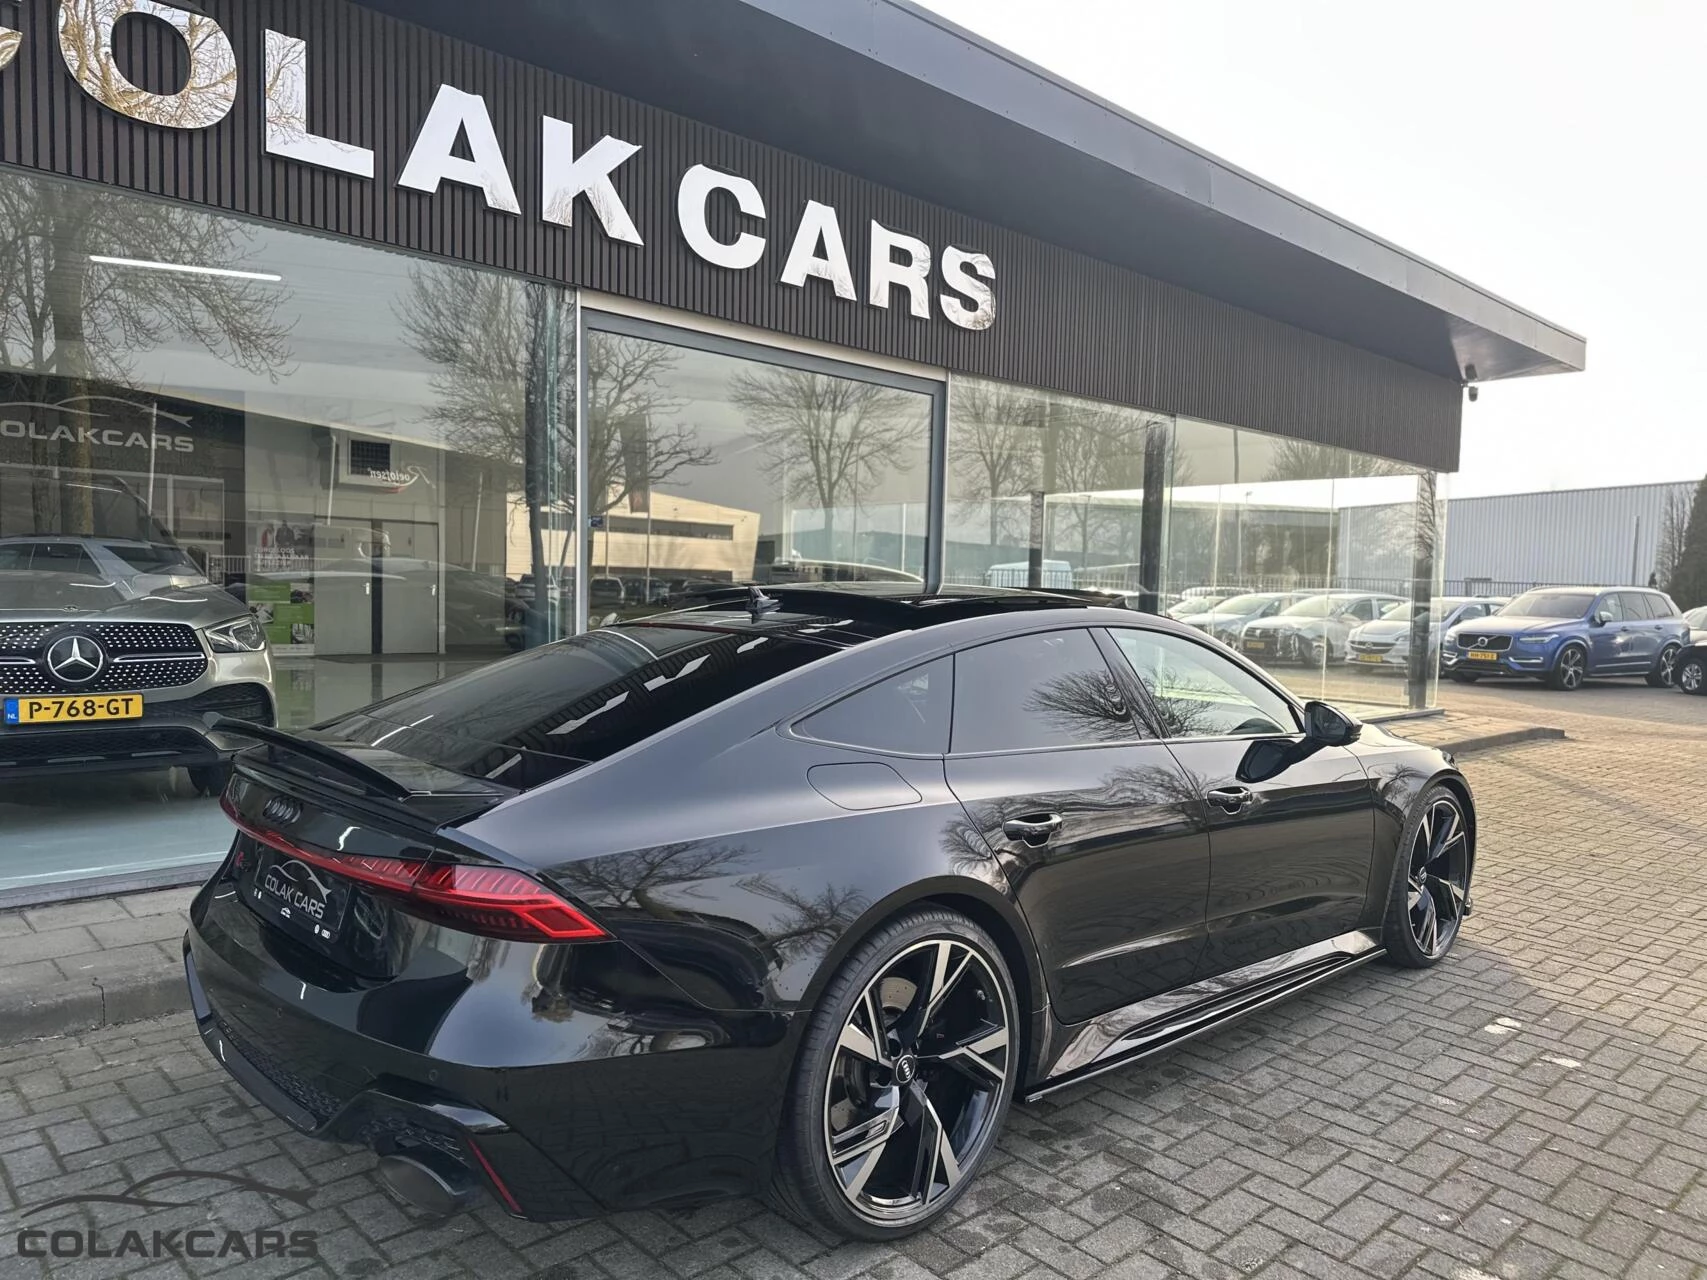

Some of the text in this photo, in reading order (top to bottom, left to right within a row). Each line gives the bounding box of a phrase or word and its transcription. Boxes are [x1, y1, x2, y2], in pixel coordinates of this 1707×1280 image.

[0, 0, 997, 331] OLAK CARS
[28, 698, 134, 719] P-768-GT
[264, 874, 326, 919] COLAK CARS
